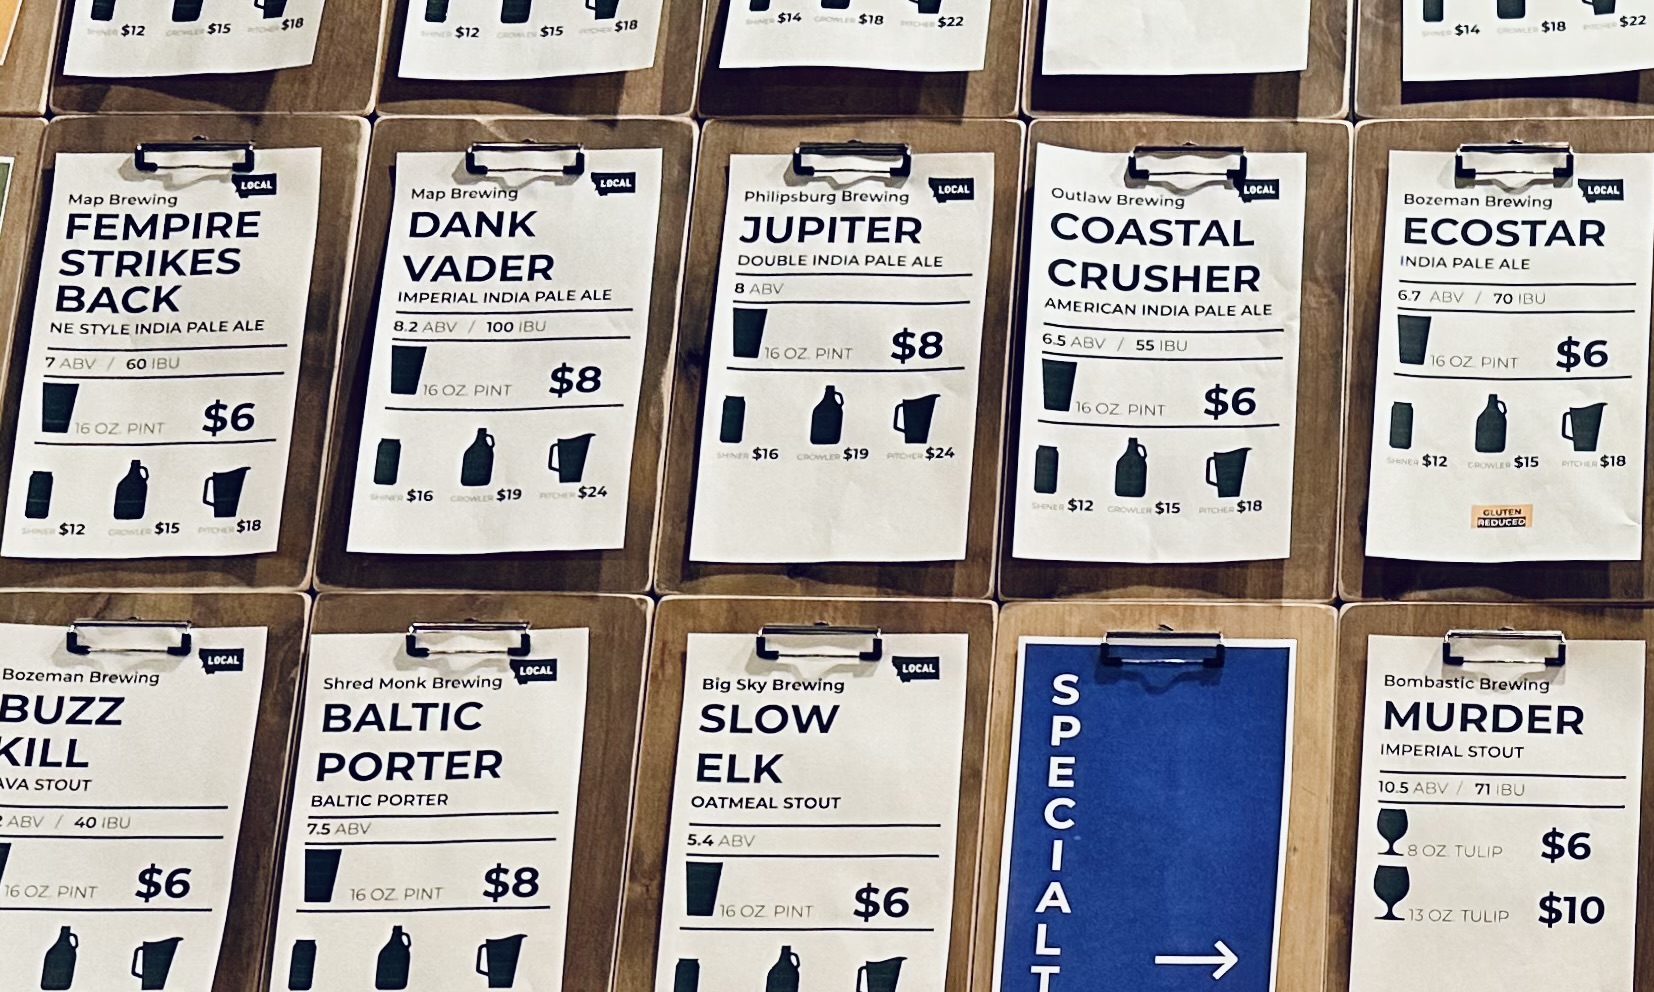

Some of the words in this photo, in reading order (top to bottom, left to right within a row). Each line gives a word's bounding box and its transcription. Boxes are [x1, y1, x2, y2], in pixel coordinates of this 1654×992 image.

[121, 24, 145, 37] $12
[207, 23, 231, 35] $15
[281, 17, 304, 31] $18
[241, 180, 273, 190] LOCAL
[600, 178, 632, 188] LOCAL
[1243, 185, 1276, 195] LOCAL
[69, 194, 104, 207] Map
[109, 194, 177, 208] Brewing
[412, 188, 445, 202] Map
[451, 187, 518, 202] Brewing
[745, 191, 836, 205] Philipsburg
[842, 190, 909, 205] Brewing
[1052, 188, 1112, 204] Outlaw
[1117, 195, 1185, 209] Brewing
[1404, 194, 1479, 206] Bozeman
[1486, 195, 1552, 210] Brewing
[66, 211, 261, 241] FEMPIRE
[409, 211, 538, 238] DANK
[739, 216, 922, 244] JUPITER
[1051, 213, 1254, 246] COASTAL
[1404, 217, 1605, 247] ECOSTAR
[59, 248, 241, 278] STRIKES
[403, 254, 554, 282] VADER
[1048, 259, 1260, 292] CRUSHER
[398, 291, 478, 303] IMPERIAL
[483, 292, 530, 303] INDIA
[535, 290, 576, 302] PALE
[580, 289, 612, 301] ALE
[735, 283, 744, 294] 8
[750, 283, 784, 294] ABV
[56, 285, 182, 314] BACK
[50, 322, 74, 334] NE
[79, 324, 131, 336] STYLE
[135, 322, 182, 335] INDIA
[187, 321, 228, 333] PALE
[232, 320, 265, 332] ALE
[891, 327, 943, 364] $8
[1556, 336, 1608, 372] $6
[549, 362, 601, 398] $8
[1204, 383, 1256, 420] $6
[202, 399, 255, 437] $6
[406, 489, 433, 503] $16
[496, 488, 522, 502] $19
[578, 486, 607, 499] $24
[1483, 508, 1522, 517] GLUTEN
[59, 522, 85, 536] $12
[154, 521, 180, 535] $15
[236, 519, 261, 534] $18
[1477, 517, 1526, 528] REDUCED
[208, 655, 240, 665] LOCAL
[3, 668, 83, 682] Bozeman
[90, 671, 159, 686] Brewing
[323, 677, 373, 690] Shred
[379, 677, 426, 689] Monk
[433, 675, 502, 690] Brewing
[703, 677, 730, 693] Big
[736, 678, 767, 694] Sky
[773, 677, 844, 694] Brewing
[1384, 674, 1475, 691] Bombastic
[1479, 676, 1550, 694] Brewing
[0, 694, 125, 725] BUZZ
[322, 702, 483, 732] BALTIC
[1384, 701, 1584, 735] MURDER
[699, 704, 840, 734] SLOW
[0, 737, 89, 768] KILL
[1381, 744, 1463, 757] IMPERIAL
[1468, 746, 1524, 758] STOUT
[316, 750, 502, 782] PORTER
[696, 753, 784, 783] ELK
[311, 795, 372, 807] BALTIC
[377, 794, 448, 806] PORTER
[691, 796, 778, 809] OATMEAL
[783, 797, 841, 809] STOUT
[307, 823, 330, 835] 7.5
[335, 823, 371, 835] ABV
[1541, 827, 1591, 863] $6
[135, 863, 192, 903] $6
[483, 863, 539, 903] $8
[853, 882, 909, 922] $6
[1538, 891, 1605, 928] $10
